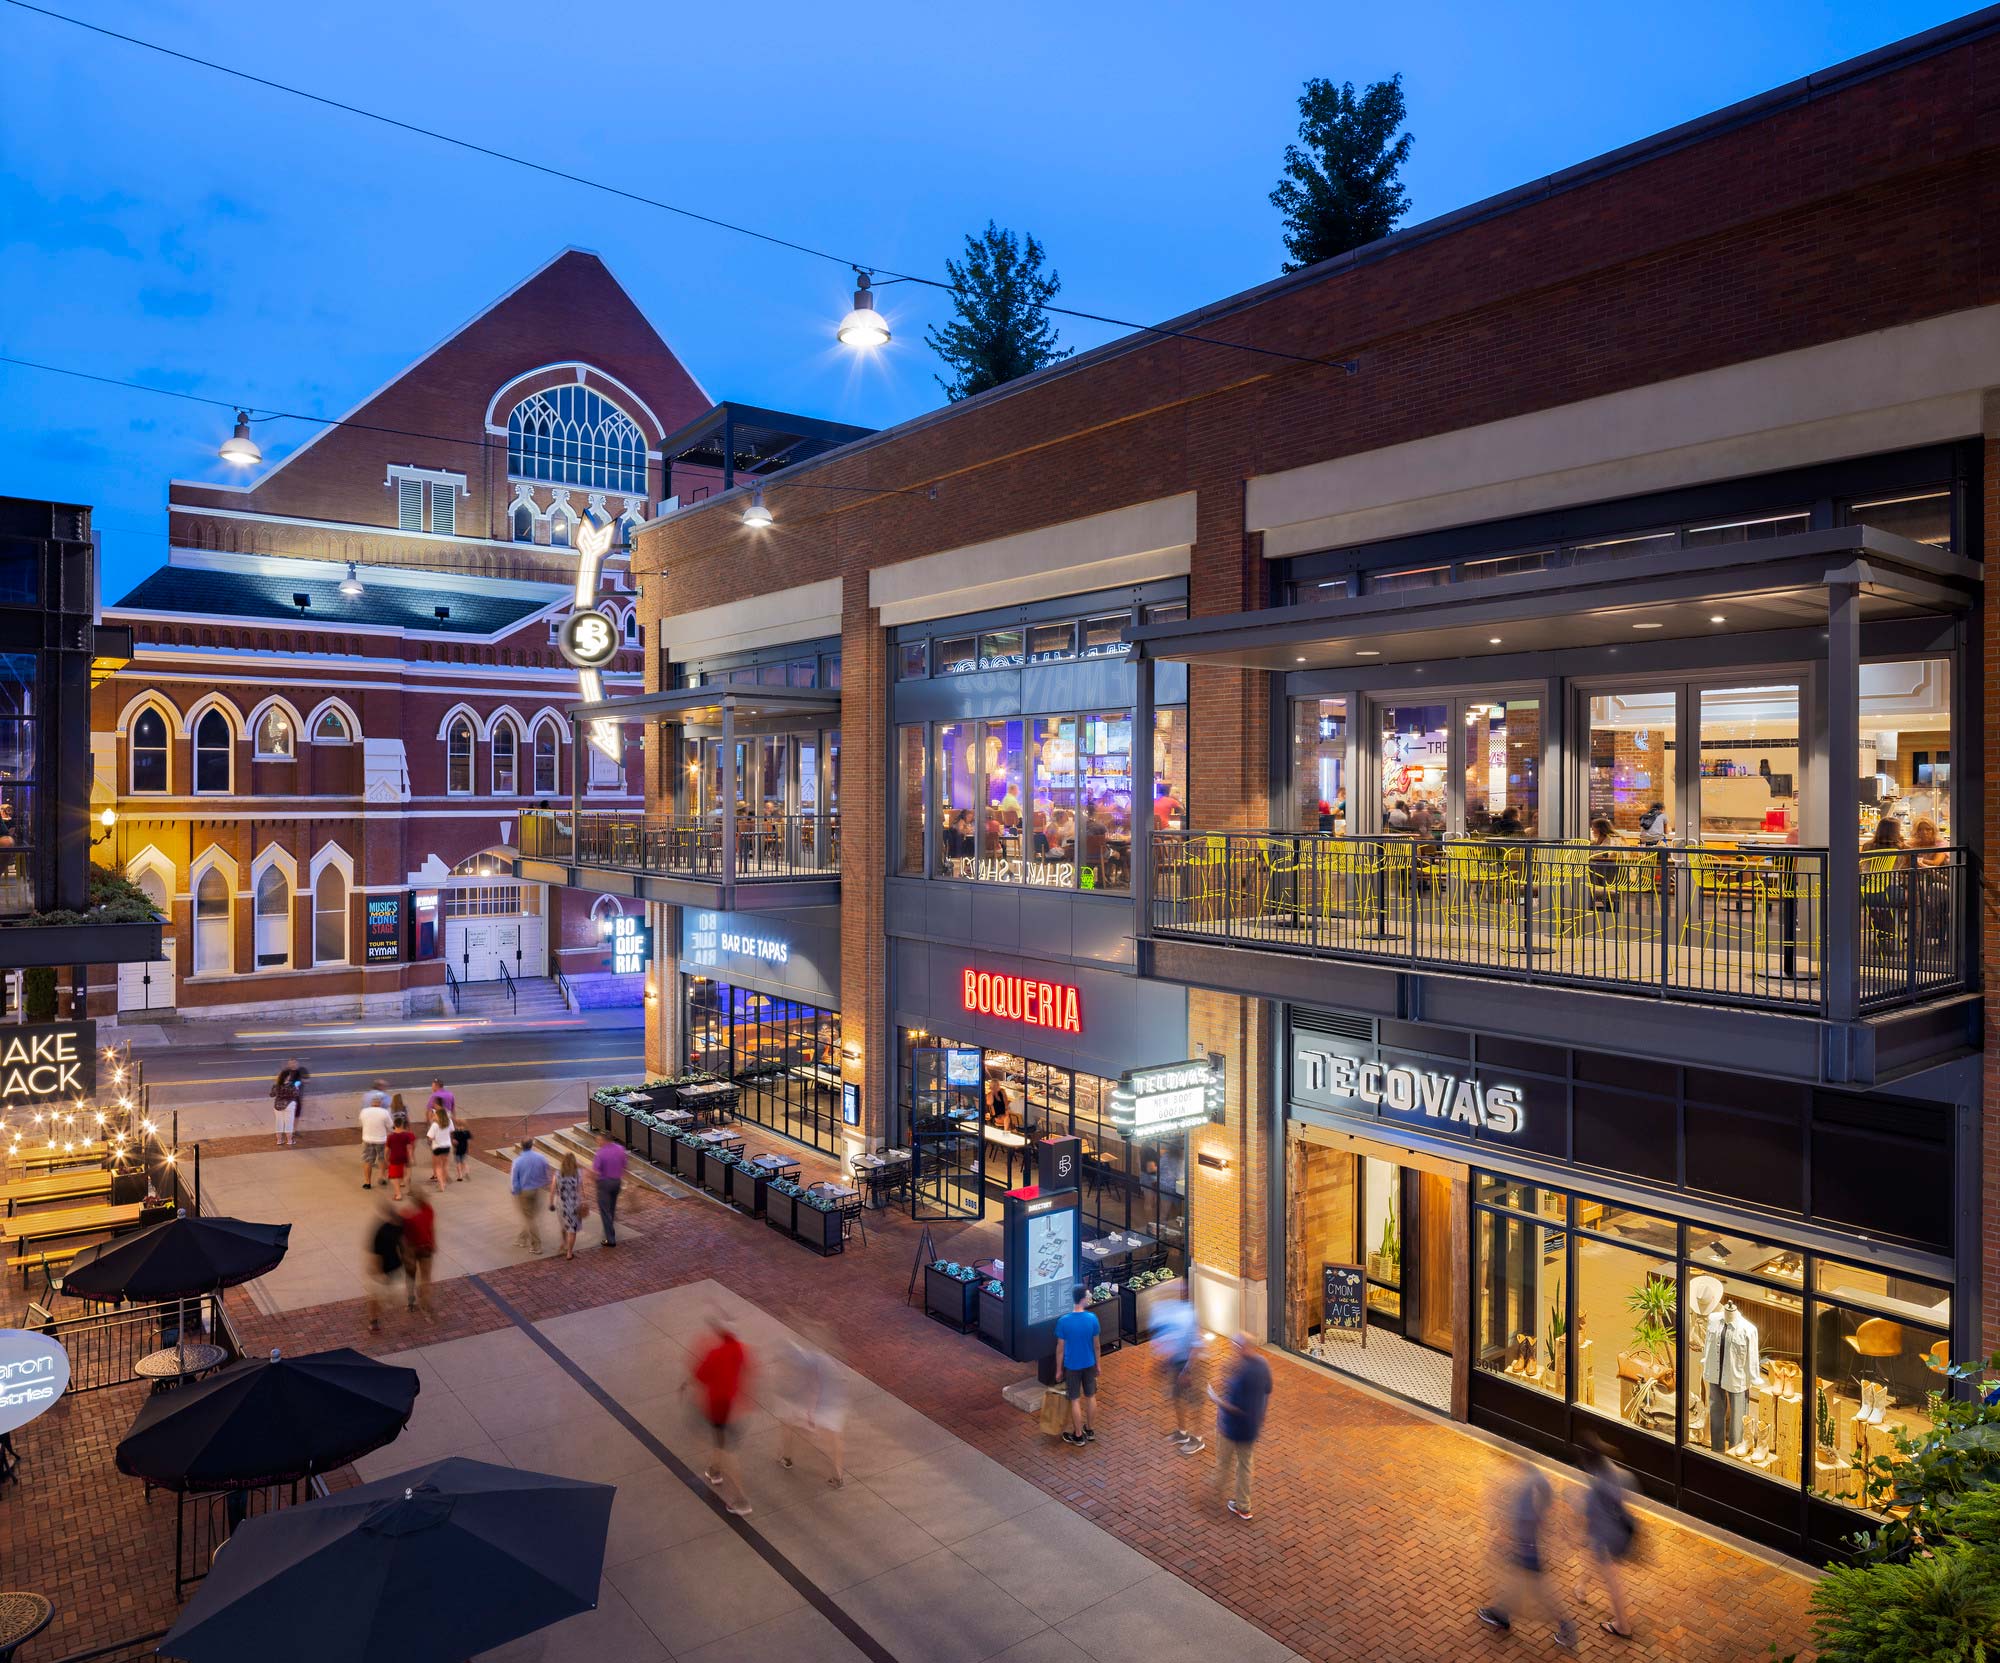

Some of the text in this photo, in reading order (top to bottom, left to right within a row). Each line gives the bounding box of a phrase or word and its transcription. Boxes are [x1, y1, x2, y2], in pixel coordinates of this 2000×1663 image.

[369, 901, 398, 913] MUSIC'S
[369, 915, 397, 925] ICONIC
[372, 924, 394, 935] STAGE
[368, 946, 398, 957] RYMAN
[721, 933, 788, 962] BAR DE TAPAS
[964, 968, 1082, 1033] BOQUERIA
[0, 1032, 78, 1067] AKE
[0, 1062, 83, 1098] ACK
[1133, 1066, 1210, 1095] TECOVAS
[1297, 1050, 1525, 1134] TECOVAS
[1028, 1201, 1052, 1213] DIRECTORY
[1327, 1283, 1353, 1296] C'MON
[1331, 1303, 1350, 1317] A/C
